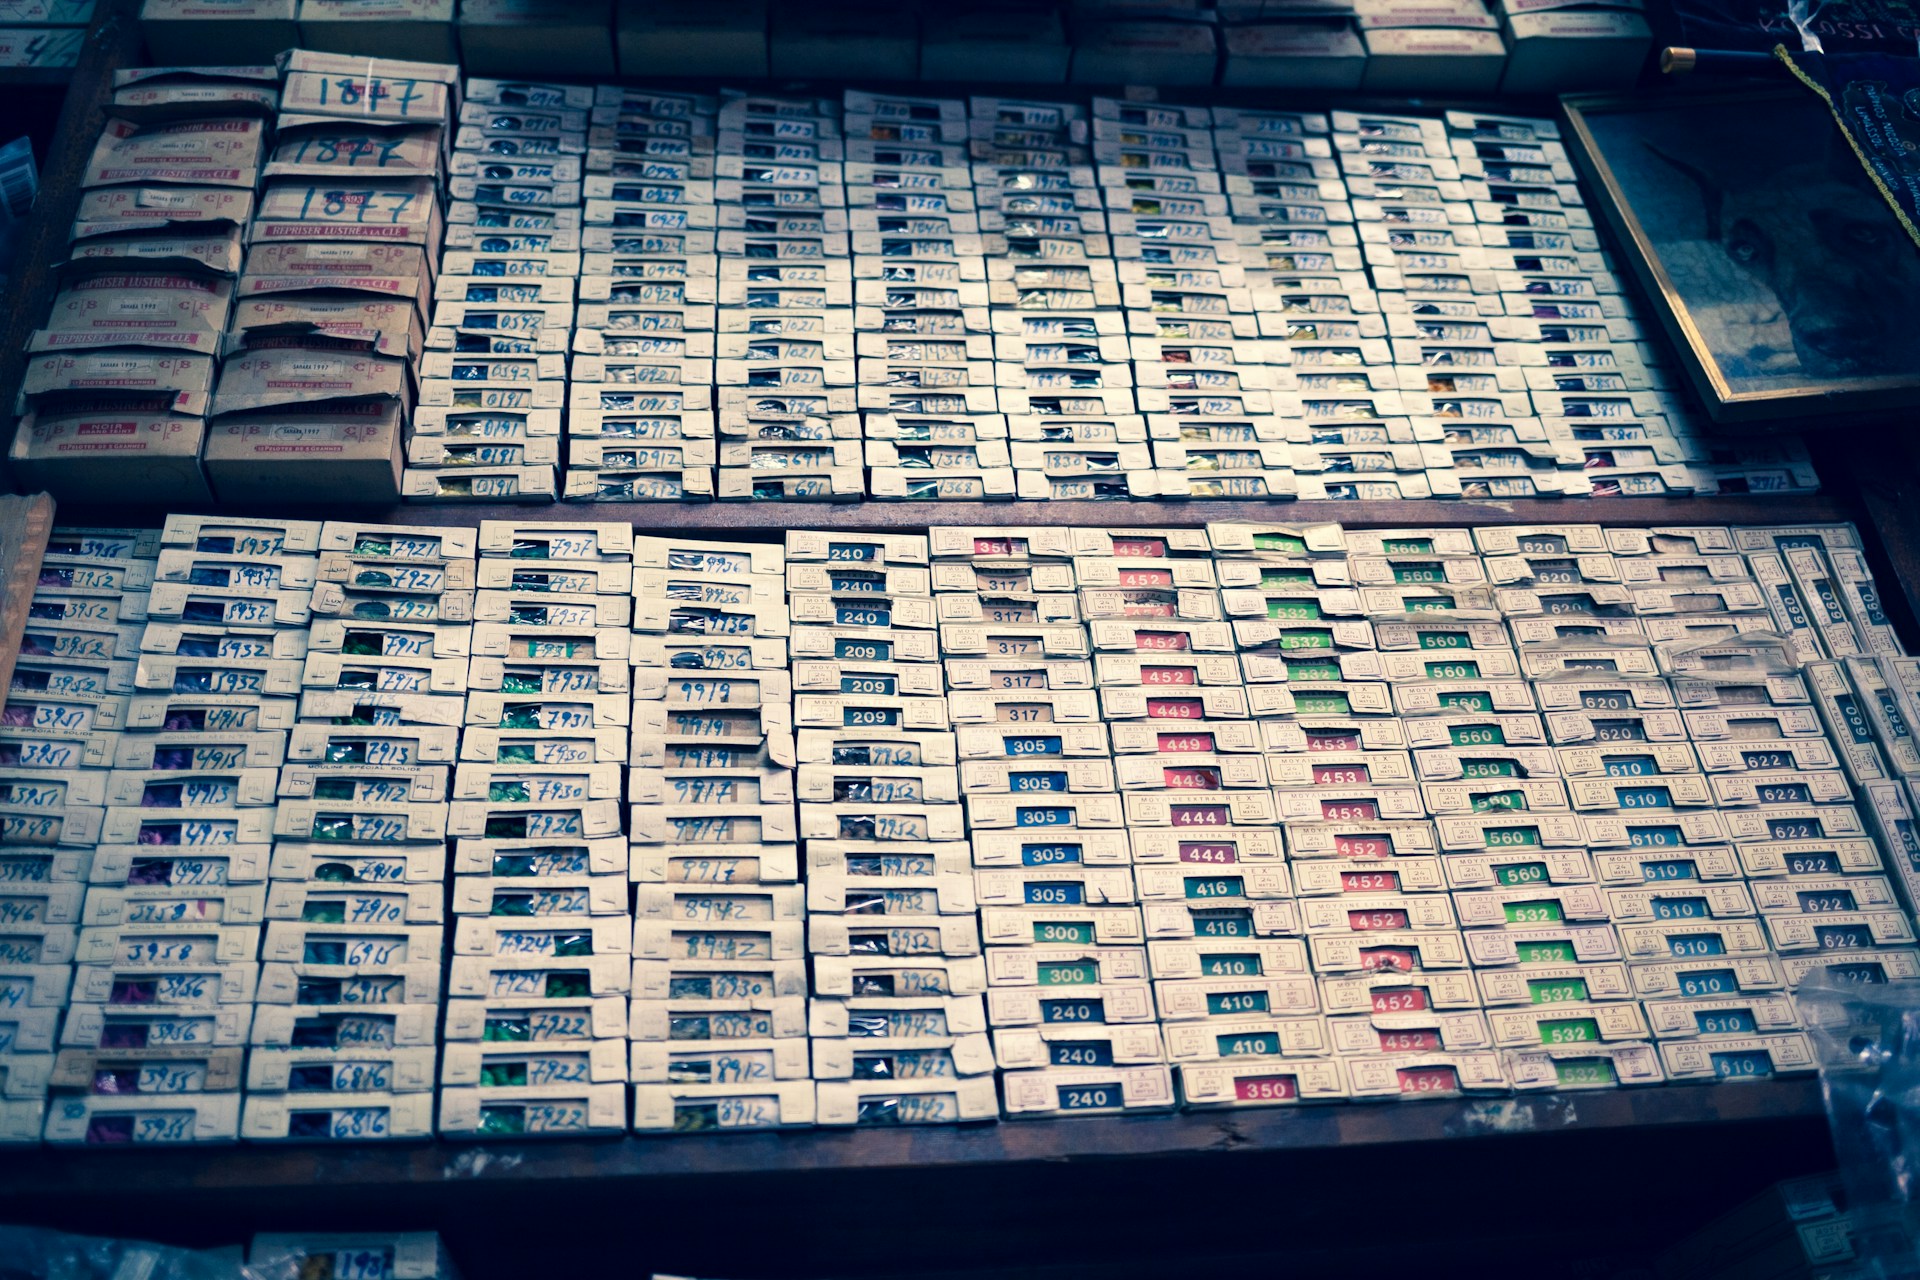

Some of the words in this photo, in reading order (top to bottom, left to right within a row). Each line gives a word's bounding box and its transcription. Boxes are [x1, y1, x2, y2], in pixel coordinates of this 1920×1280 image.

[321, 79, 422, 114] 1877
[300, 187, 416, 223] 1877
[272, 226, 321, 235] REPRISER
[78, 278, 126, 289] REPRISER
[1119, 546, 1152, 556] 452
[1390, 544, 1418, 553] 560
[1524, 542, 1555, 553] 620
[832, 549, 863, 560] 240
[1127, 575, 1160, 586] 452
[1403, 571, 1432, 581] 560
[1539, 572, 1570, 583] 620
[840, 582, 872, 592] 240
[989, 580, 1016, 590] 317
[1784, 597, 1804, 624] 660
[1822, 592, 1842, 620] 660
[1863, 594, 1883, 621] 660
[844, 612, 877, 623] 240
[994, 611, 1022, 621] 317
[1277, 608, 1308, 619] 532
[1143, 638, 1178, 648] 452
[1290, 637, 1320, 648] 532
[1426, 636, 1457, 647] 560
[845, 646, 876, 658] 209
[999, 643, 1027, 653] 317
[1149, 672, 1184, 682] 452
[1298, 669, 1329, 680] 532
[1434, 666, 1465, 678] 560
[852, 680, 885, 693] 209
[1003, 677, 1031, 688] 317
[1305, 701, 1336, 713] 532
[1586, 696, 1619, 710] 620
[853, 711, 886, 723] 209
[1010, 710, 1038, 721] 317
[1157, 706, 1190, 716] 449
[1846, 706, 1866, 736] 660
[1885, 704, 1905, 734] 660
[1460, 731, 1492, 743] 560
[1600, 729, 1632, 740] 620
[1014, 740, 1046, 752] 305
[1167, 739, 1200, 750] 449
[1312, 739, 1345, 749] 453
[1748, 755, 1780, 767] 622
[1467, 763, 1499, 776] 560
[1609, 763, 1642, 776] 610
[1019, 777, 1051, 789] 305
[1172, 775, 1206, 787] 449
[1322, 772, 1356, 783] 453
[1625, 794, 1657, 806] 610
[1764, 789, 1797, 800] 622
[1024, 811, 1056, 823] 305
[1180, 812, 1216, 824] 444
[1328, 807, 1363, 820] 453
[1490, 832, 1523, 844] 560
[1776, 826, 1809, 839] 622
[1632, 834, 1665, 845] 610
[1340, 843, 1376, 854] 452
[1032, 849, 1065, 862] 305
[1190, 849, 1225, 861] 444
[1645, 865, 1678, 879] 610
[1794, 860, 1828, 872] 622
[1508, 867, 1541, 882] 560
[1348, 875, 1383, 888] 452
[1196, 881, 1228, 895] 416
[1032, 889, 1066, 902] 305
[1660, 904, 1693, 917] 610
[1808, 899, 1843, 912] 622
[1359, 914, 1396, 927] 452
[1516, 908, 1548, 921] 532
[1044, 927, 1078, 940] 300
[1206, 922, 1237, 934] 416
[1674, 940, 1707, 954] 610
[1824, 935, 1857, 948] 622
[1530, 948, 1563, 961] 532
[1212, 960, 1245, 974] 410
[1050, 969, 1084, 983] 300
[1685, 979, 1720, 993] 610
[1540, 988, 1573, 1001] 532
[1220, 996, 1254, 1010] 410
[1376, 995, 1412, 1009] 452
[1052, 1006, 1090, 1020] 240
[1706, 1018, 1739, 1031] 610
[1552, 1027, 1586, 1042] 532
[1233, 1039, 1266, 1053] 410
[1386, 1035, 1424, 1049] 452
[1060, 1049, 1096, 1064] 240
[1565, 1067, 1599, 1081] 532
[1720, 1061, 1754, 1075] 610
[1404, 1077, 1442, 1091] 452
[1247, 1083, 1285, 1099] 350
[1069, 1091, 1106, 1106] 240
